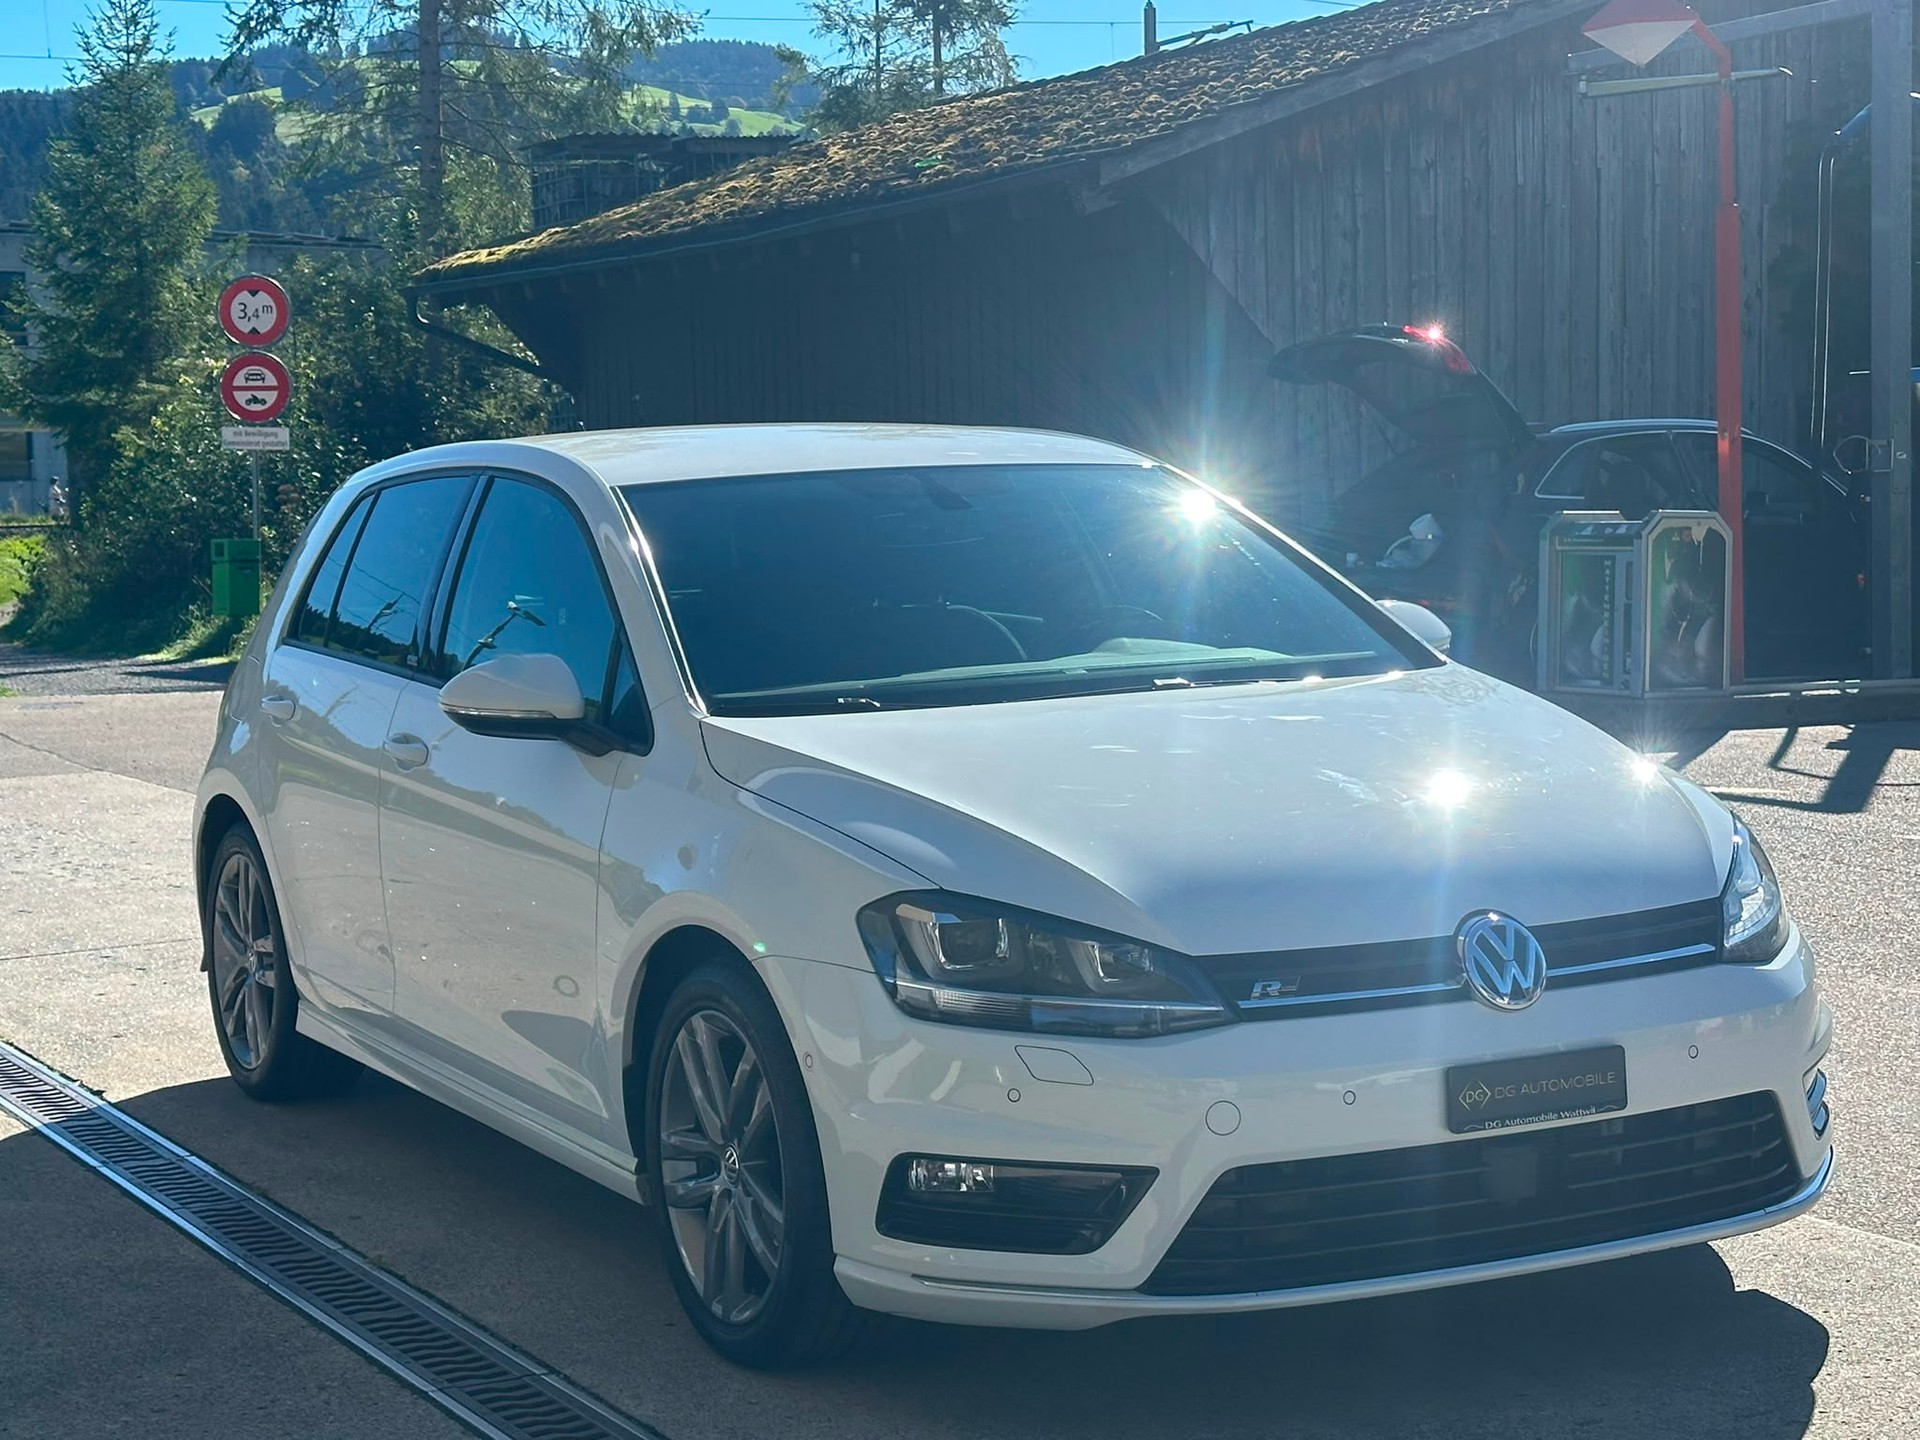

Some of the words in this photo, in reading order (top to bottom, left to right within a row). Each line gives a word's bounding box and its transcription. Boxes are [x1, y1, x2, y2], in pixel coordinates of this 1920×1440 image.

[1465, 1089, 1484, 1103] DG
[1494, 1085, 1516, 1099] DG
[1520, 1071, 1616, 1095] AUTOMOBILE
[1485, 1120, 1502, 1130] DG
[1504, 1112, 1558, 1127] Automobile
[1560, 1105, 1596, 1119] Wattwil
